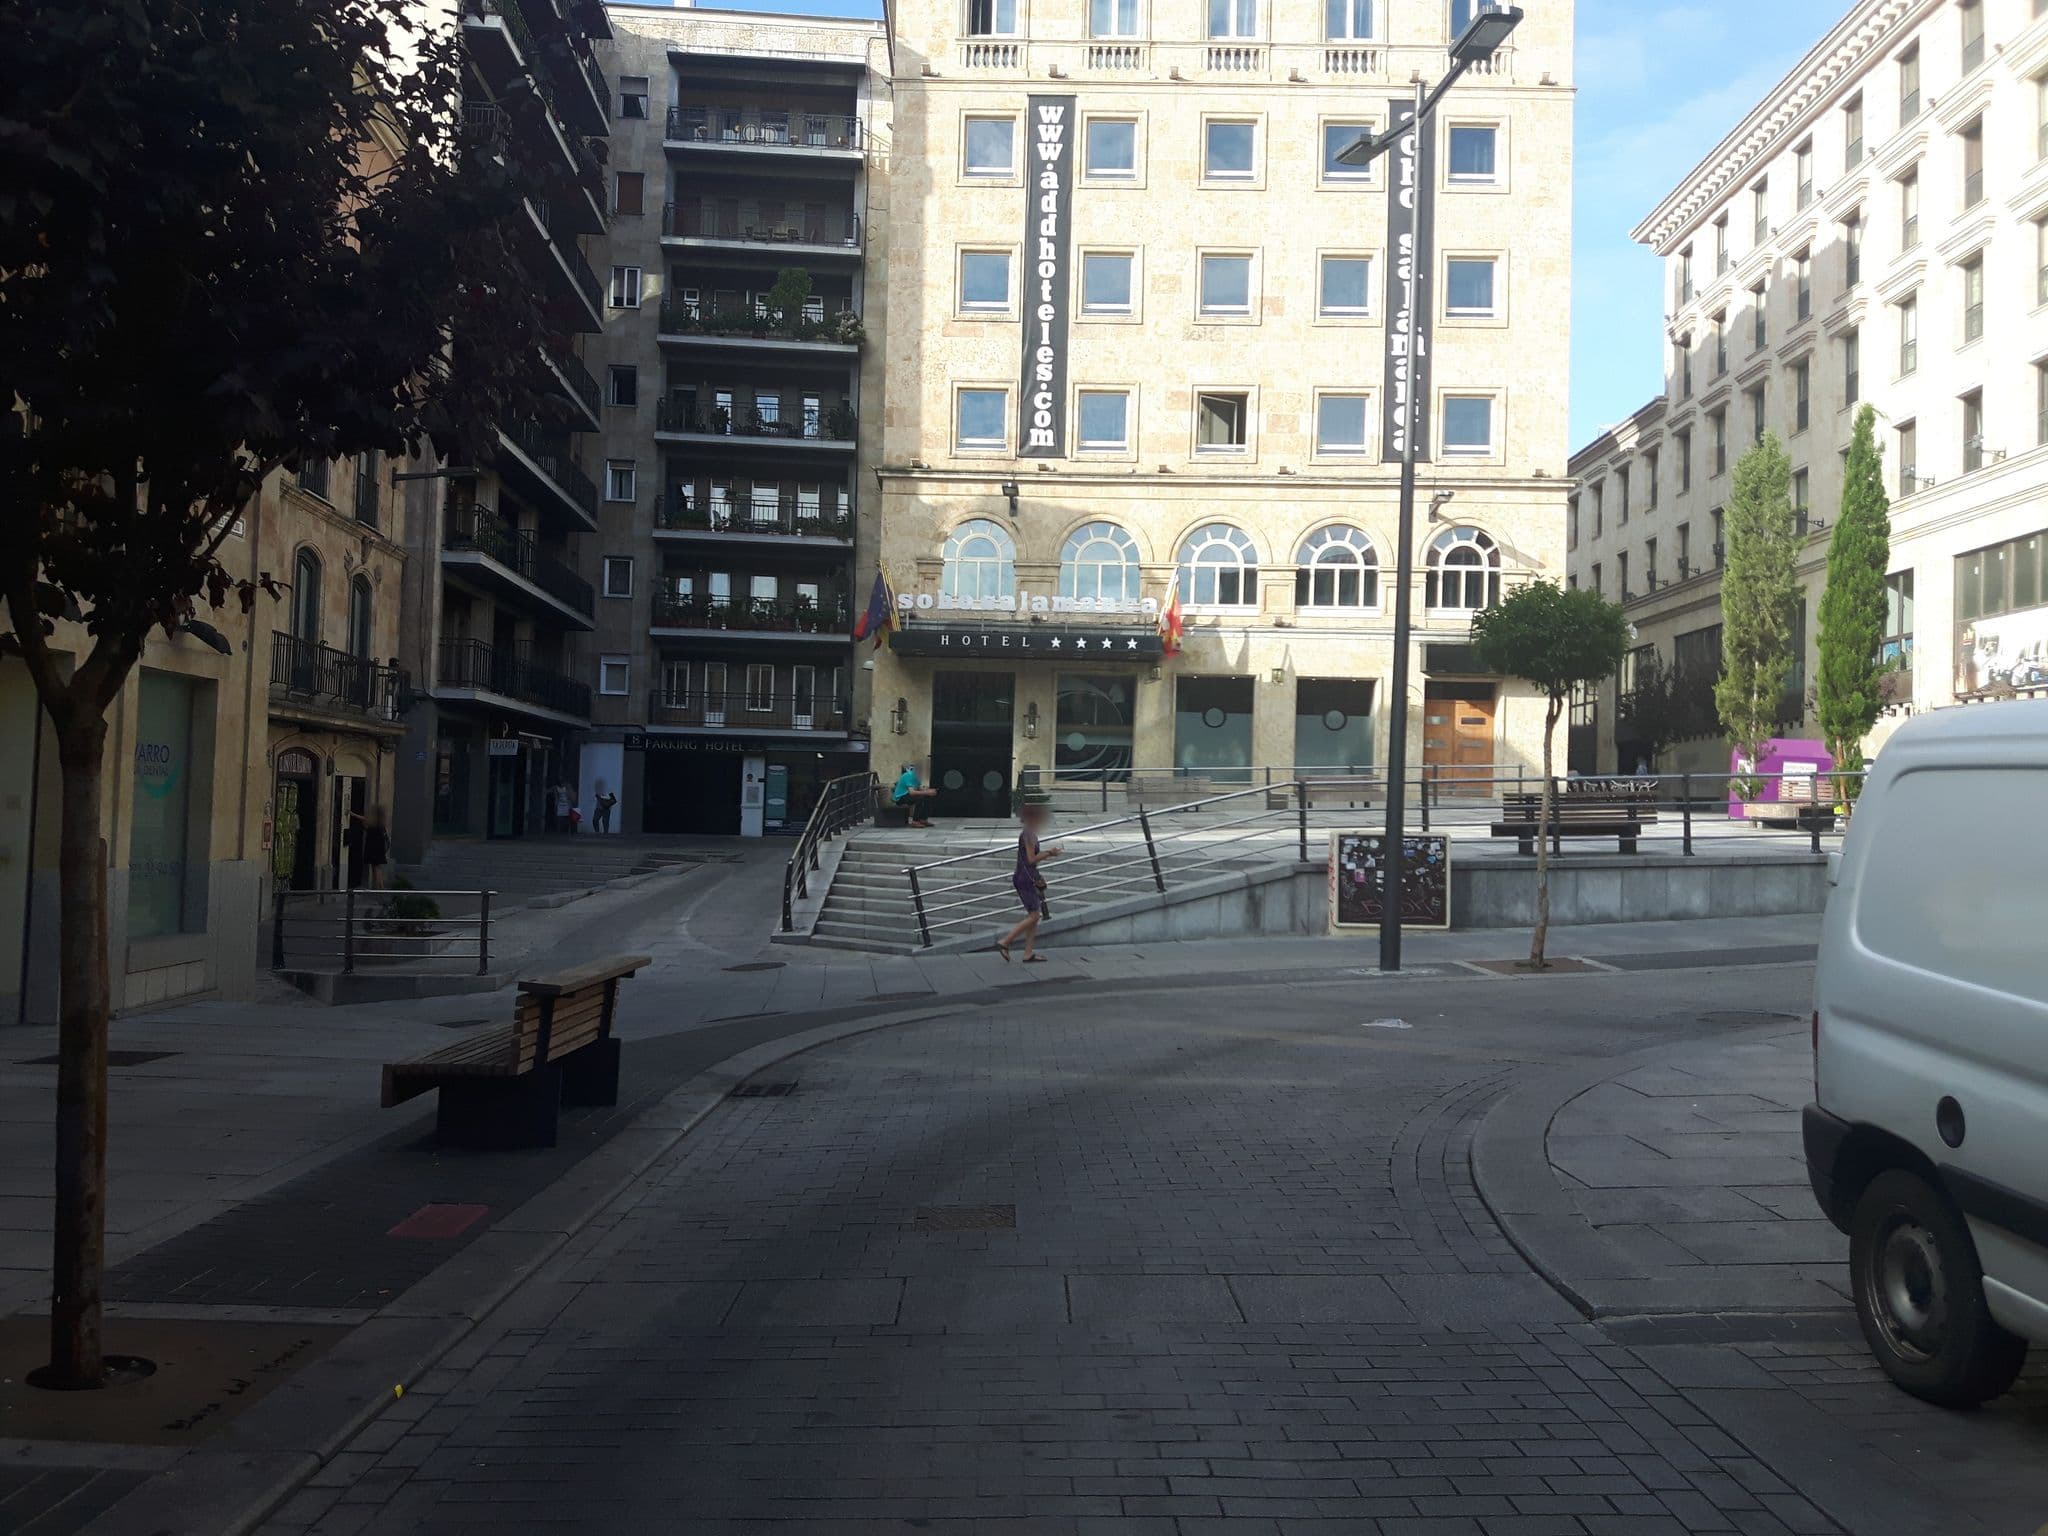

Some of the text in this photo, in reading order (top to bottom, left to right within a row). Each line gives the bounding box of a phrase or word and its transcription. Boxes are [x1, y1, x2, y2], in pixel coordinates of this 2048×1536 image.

[940, 634, 1030, 648] HOTEL
[645, 738, 697, 751] PARKING
[705, 740, 745, 752] HOTEL
